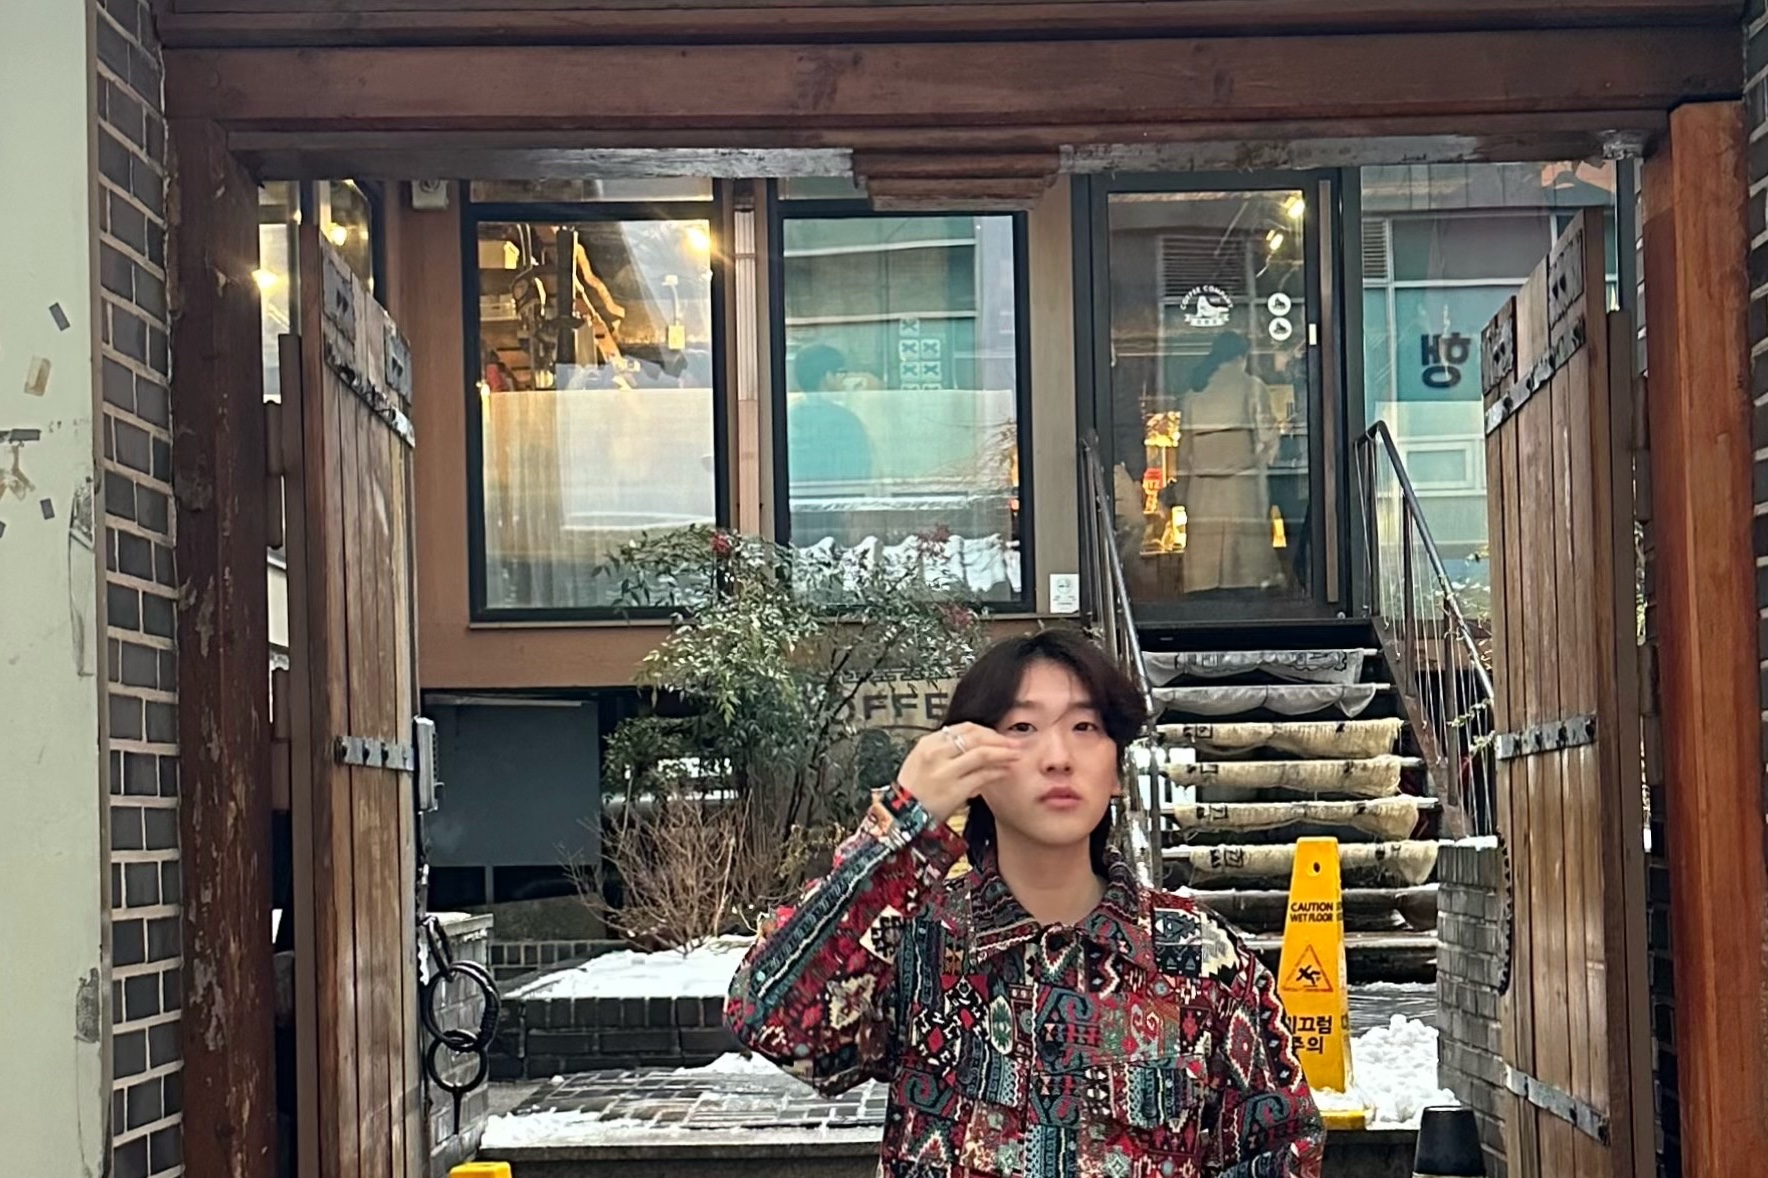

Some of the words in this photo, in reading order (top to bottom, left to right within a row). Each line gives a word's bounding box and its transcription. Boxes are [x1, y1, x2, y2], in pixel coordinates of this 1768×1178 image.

[1291, 901, 1333, 912] CAUTION
[1290, 913, 1307, 922] WET
[1309, 913, 1333, 922] FLOOR
